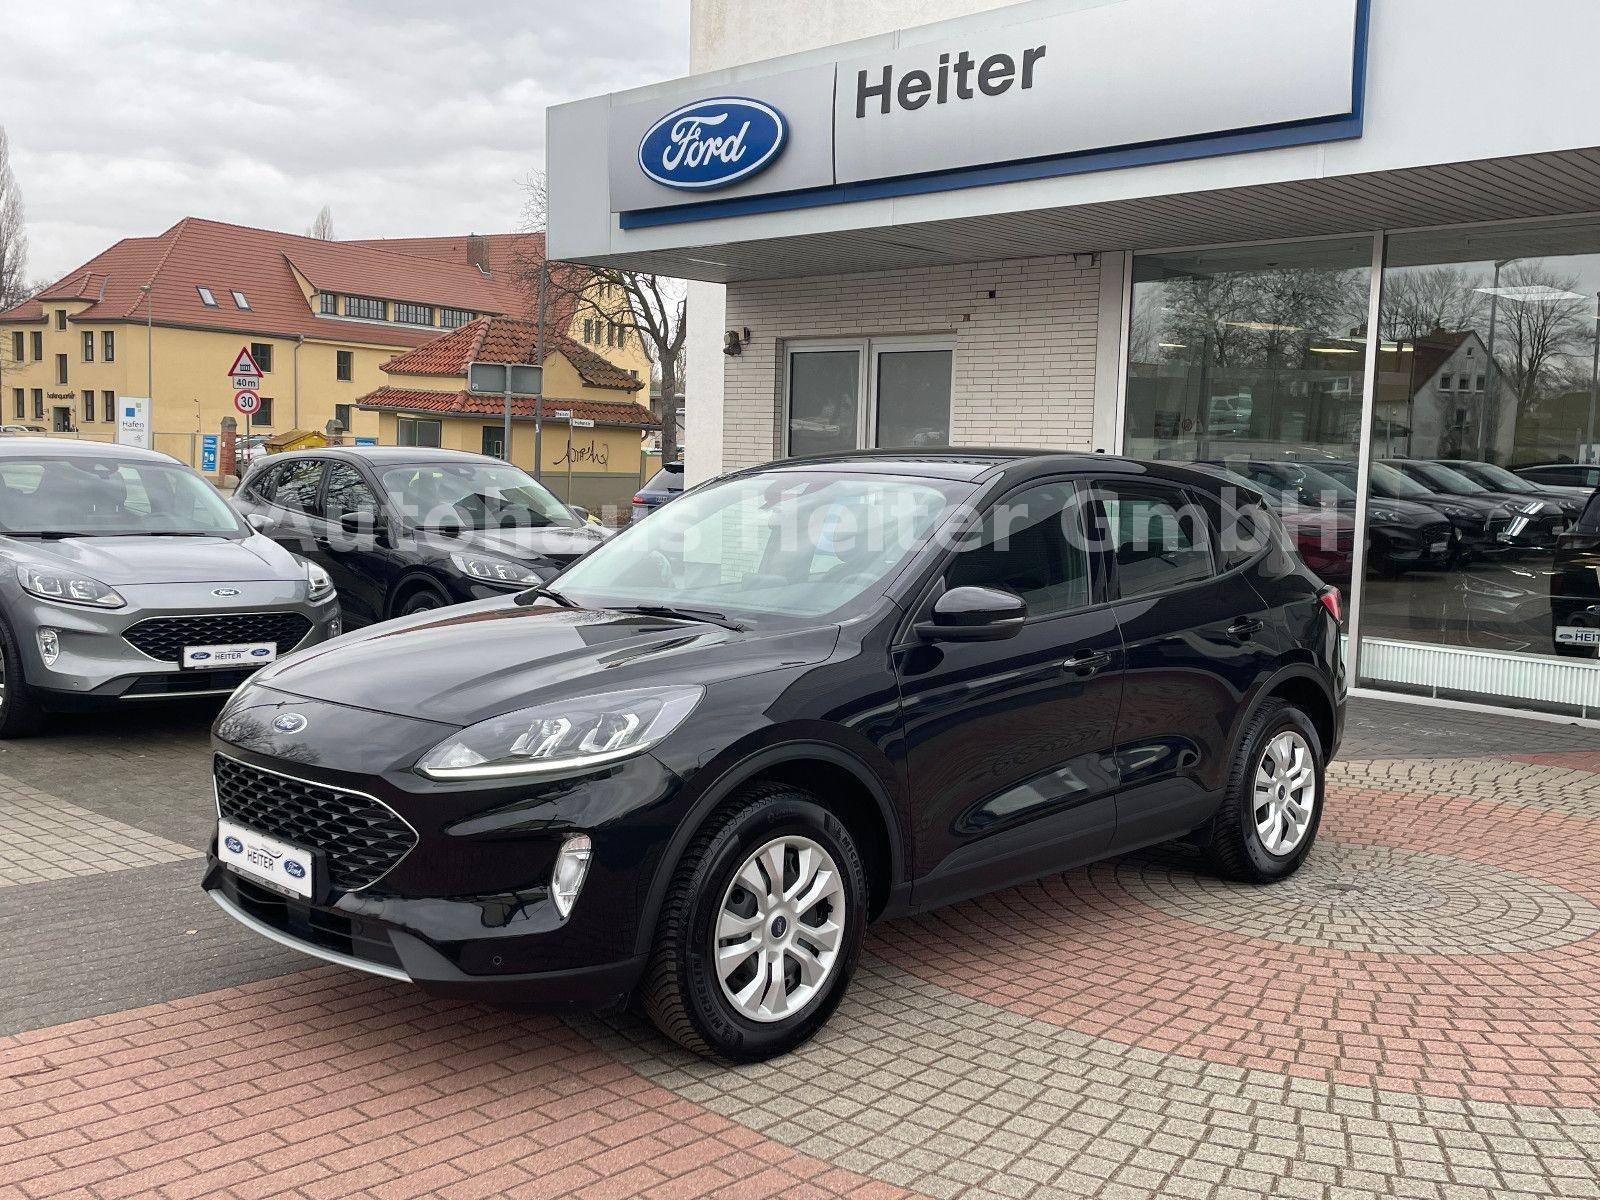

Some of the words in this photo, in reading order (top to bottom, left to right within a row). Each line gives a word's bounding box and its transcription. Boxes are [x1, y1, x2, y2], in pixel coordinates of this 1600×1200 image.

[855, 45, 1047, 118] Heiter
[662, 112, 751, 171] Ford
[237, 379, 247, 387] 40
[240, 396, 254, 408] 30
[215, 653, 242, 661] HEITER
[247, 849, 275, 872] HEITER
